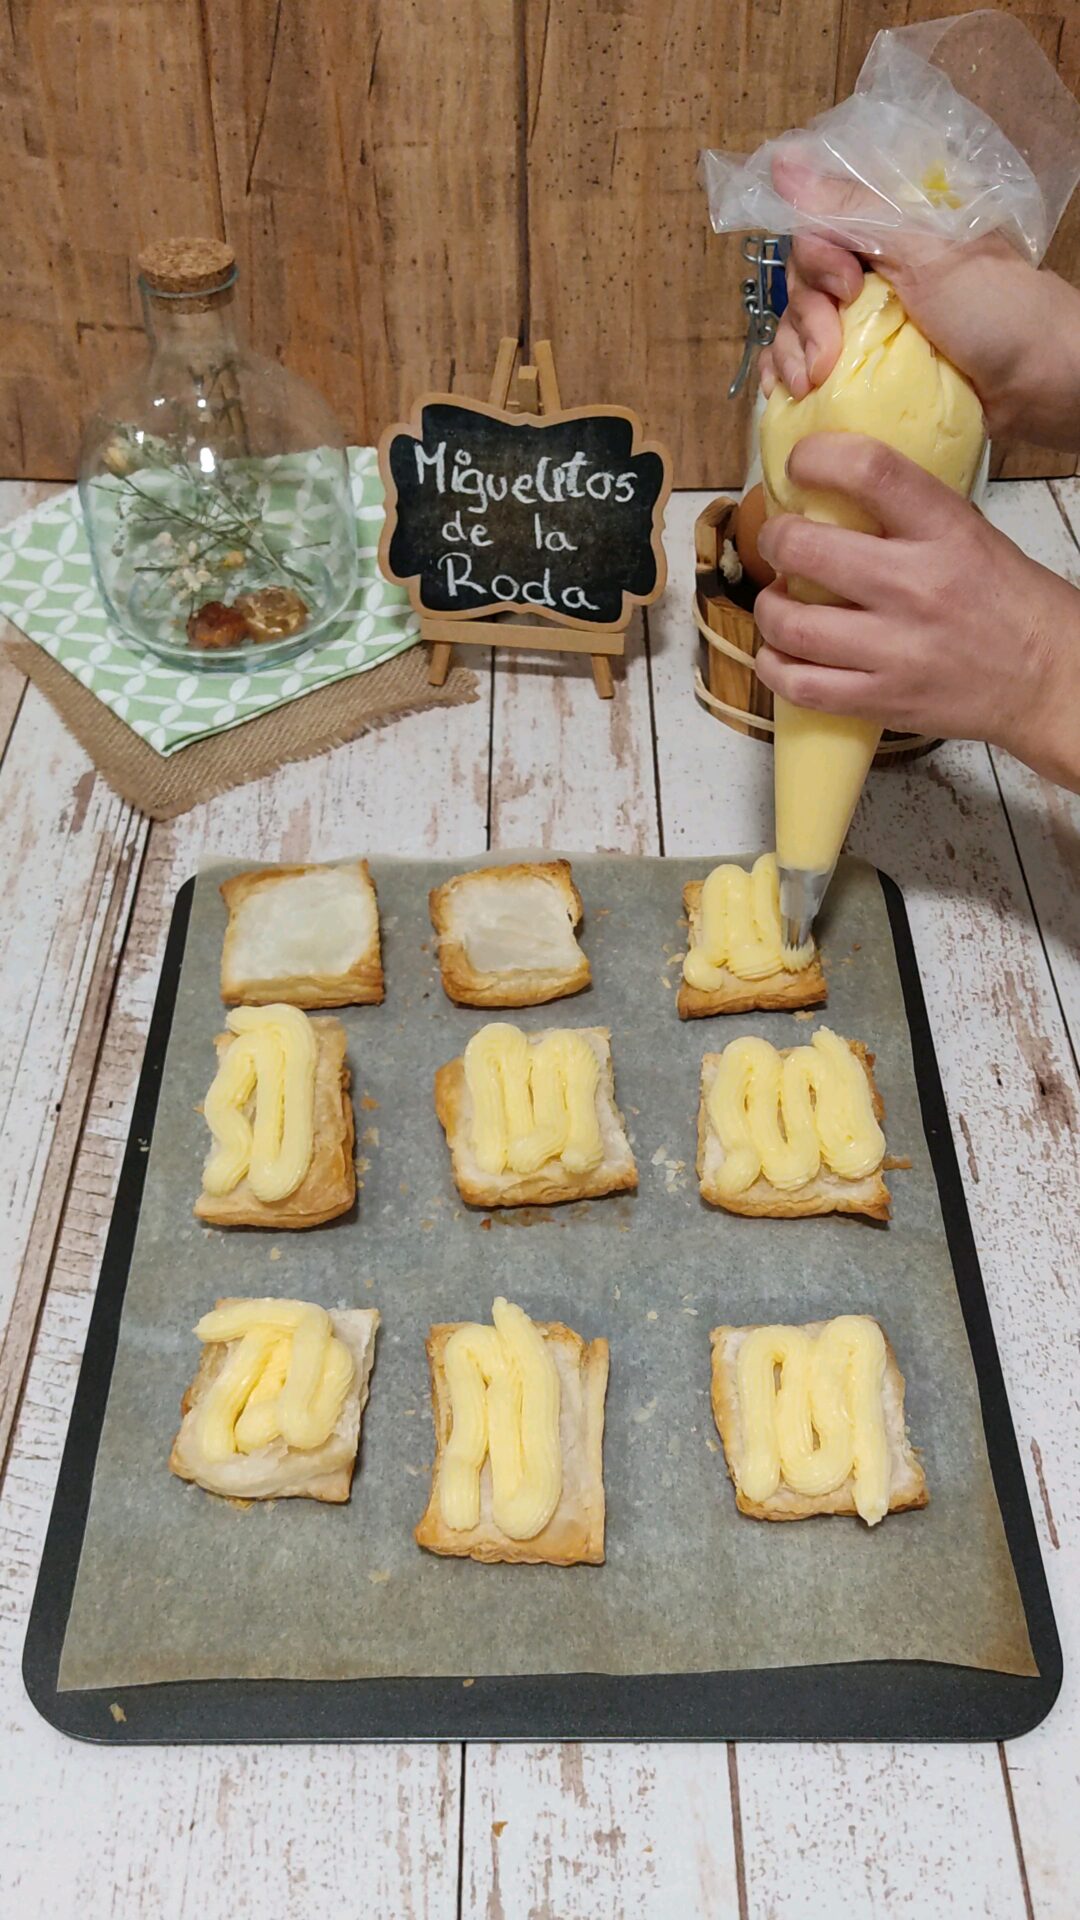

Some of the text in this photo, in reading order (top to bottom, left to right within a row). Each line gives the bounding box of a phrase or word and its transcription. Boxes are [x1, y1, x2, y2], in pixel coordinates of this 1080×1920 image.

[414, 441, 637, 513] Miguelitos
[442, 510, 578, 551] de la
[438, 552, 600, 610] Roda
